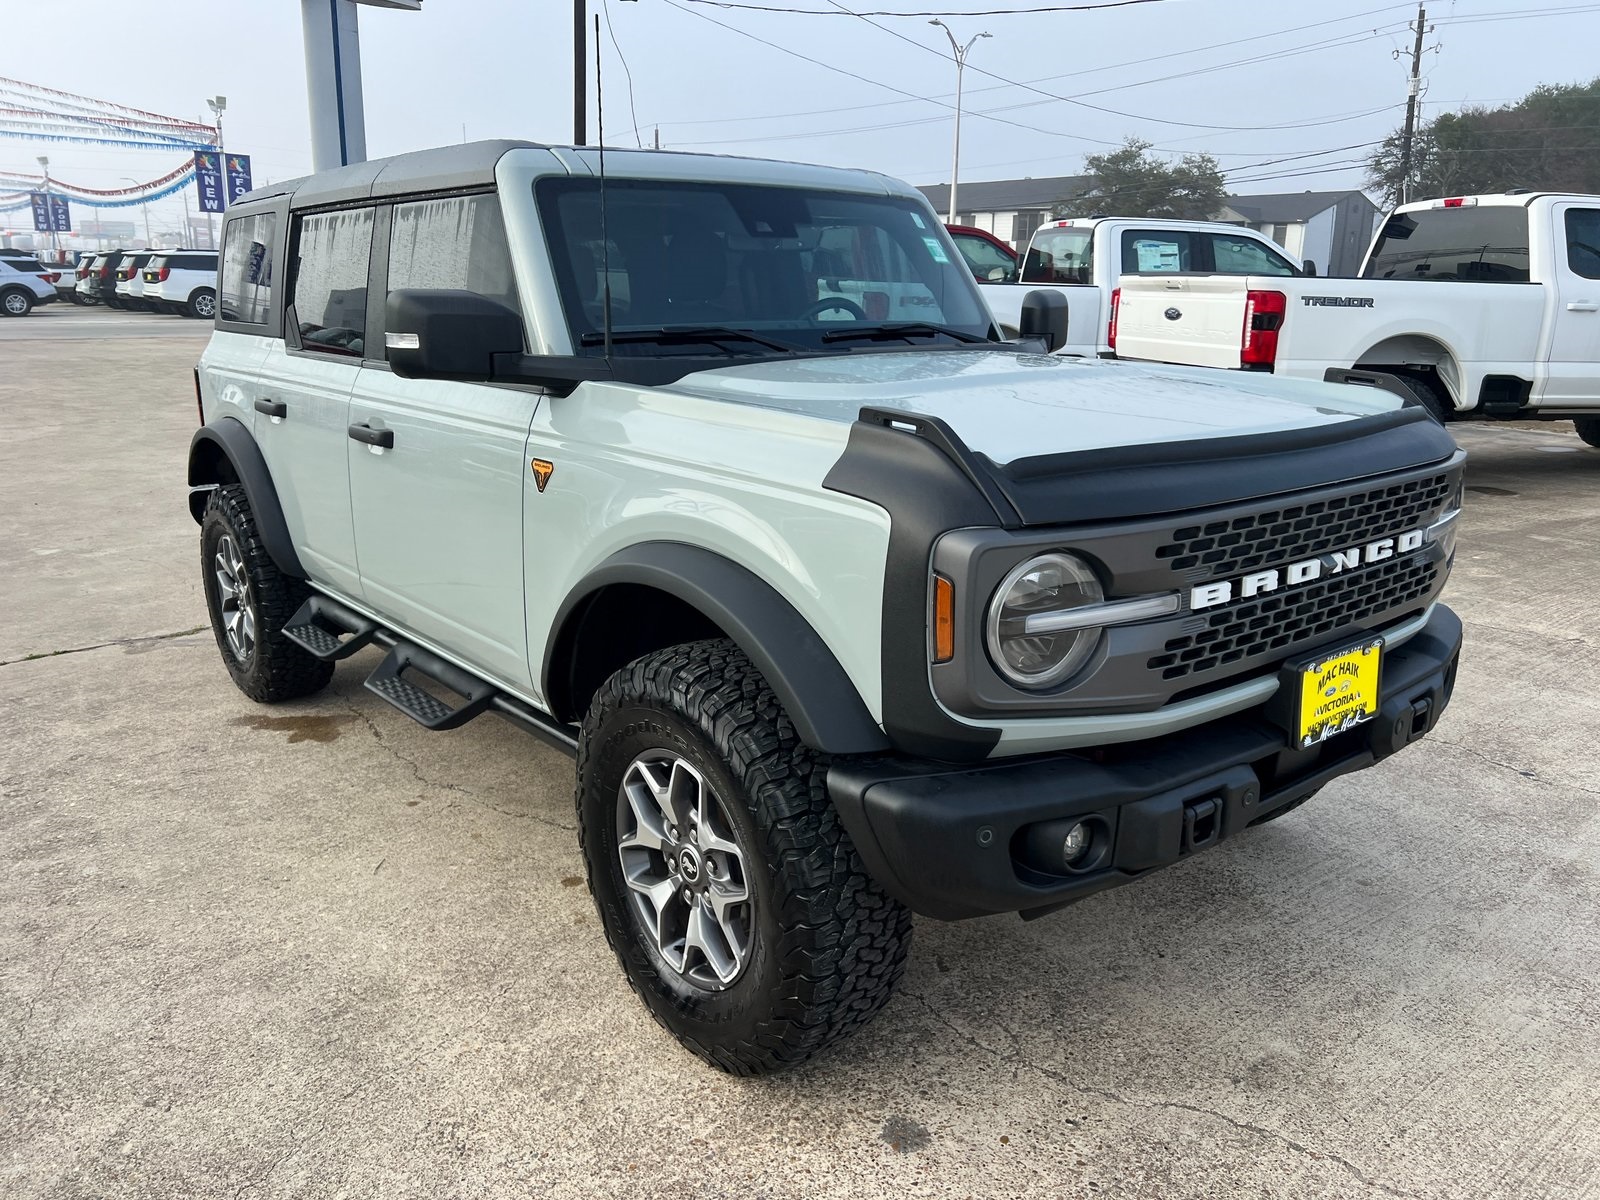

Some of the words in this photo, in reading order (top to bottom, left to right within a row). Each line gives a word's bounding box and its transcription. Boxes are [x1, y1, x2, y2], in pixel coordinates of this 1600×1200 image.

[204, 175, 218, 210] NEW
[37, 208, 47, 230] NEW
[57, 208, 66, 230] FORD
[1301, 295, 1375, 308] TREMOR
[1190, 529, 1423, 610] BRONCO
[1317, 664, 1338, 694] MAC
[1338, 661, 1360, 678] HAIK
[1318, 692, 1354, 715] VICTORIA
[1320, 724, 1339, 741] Mac
